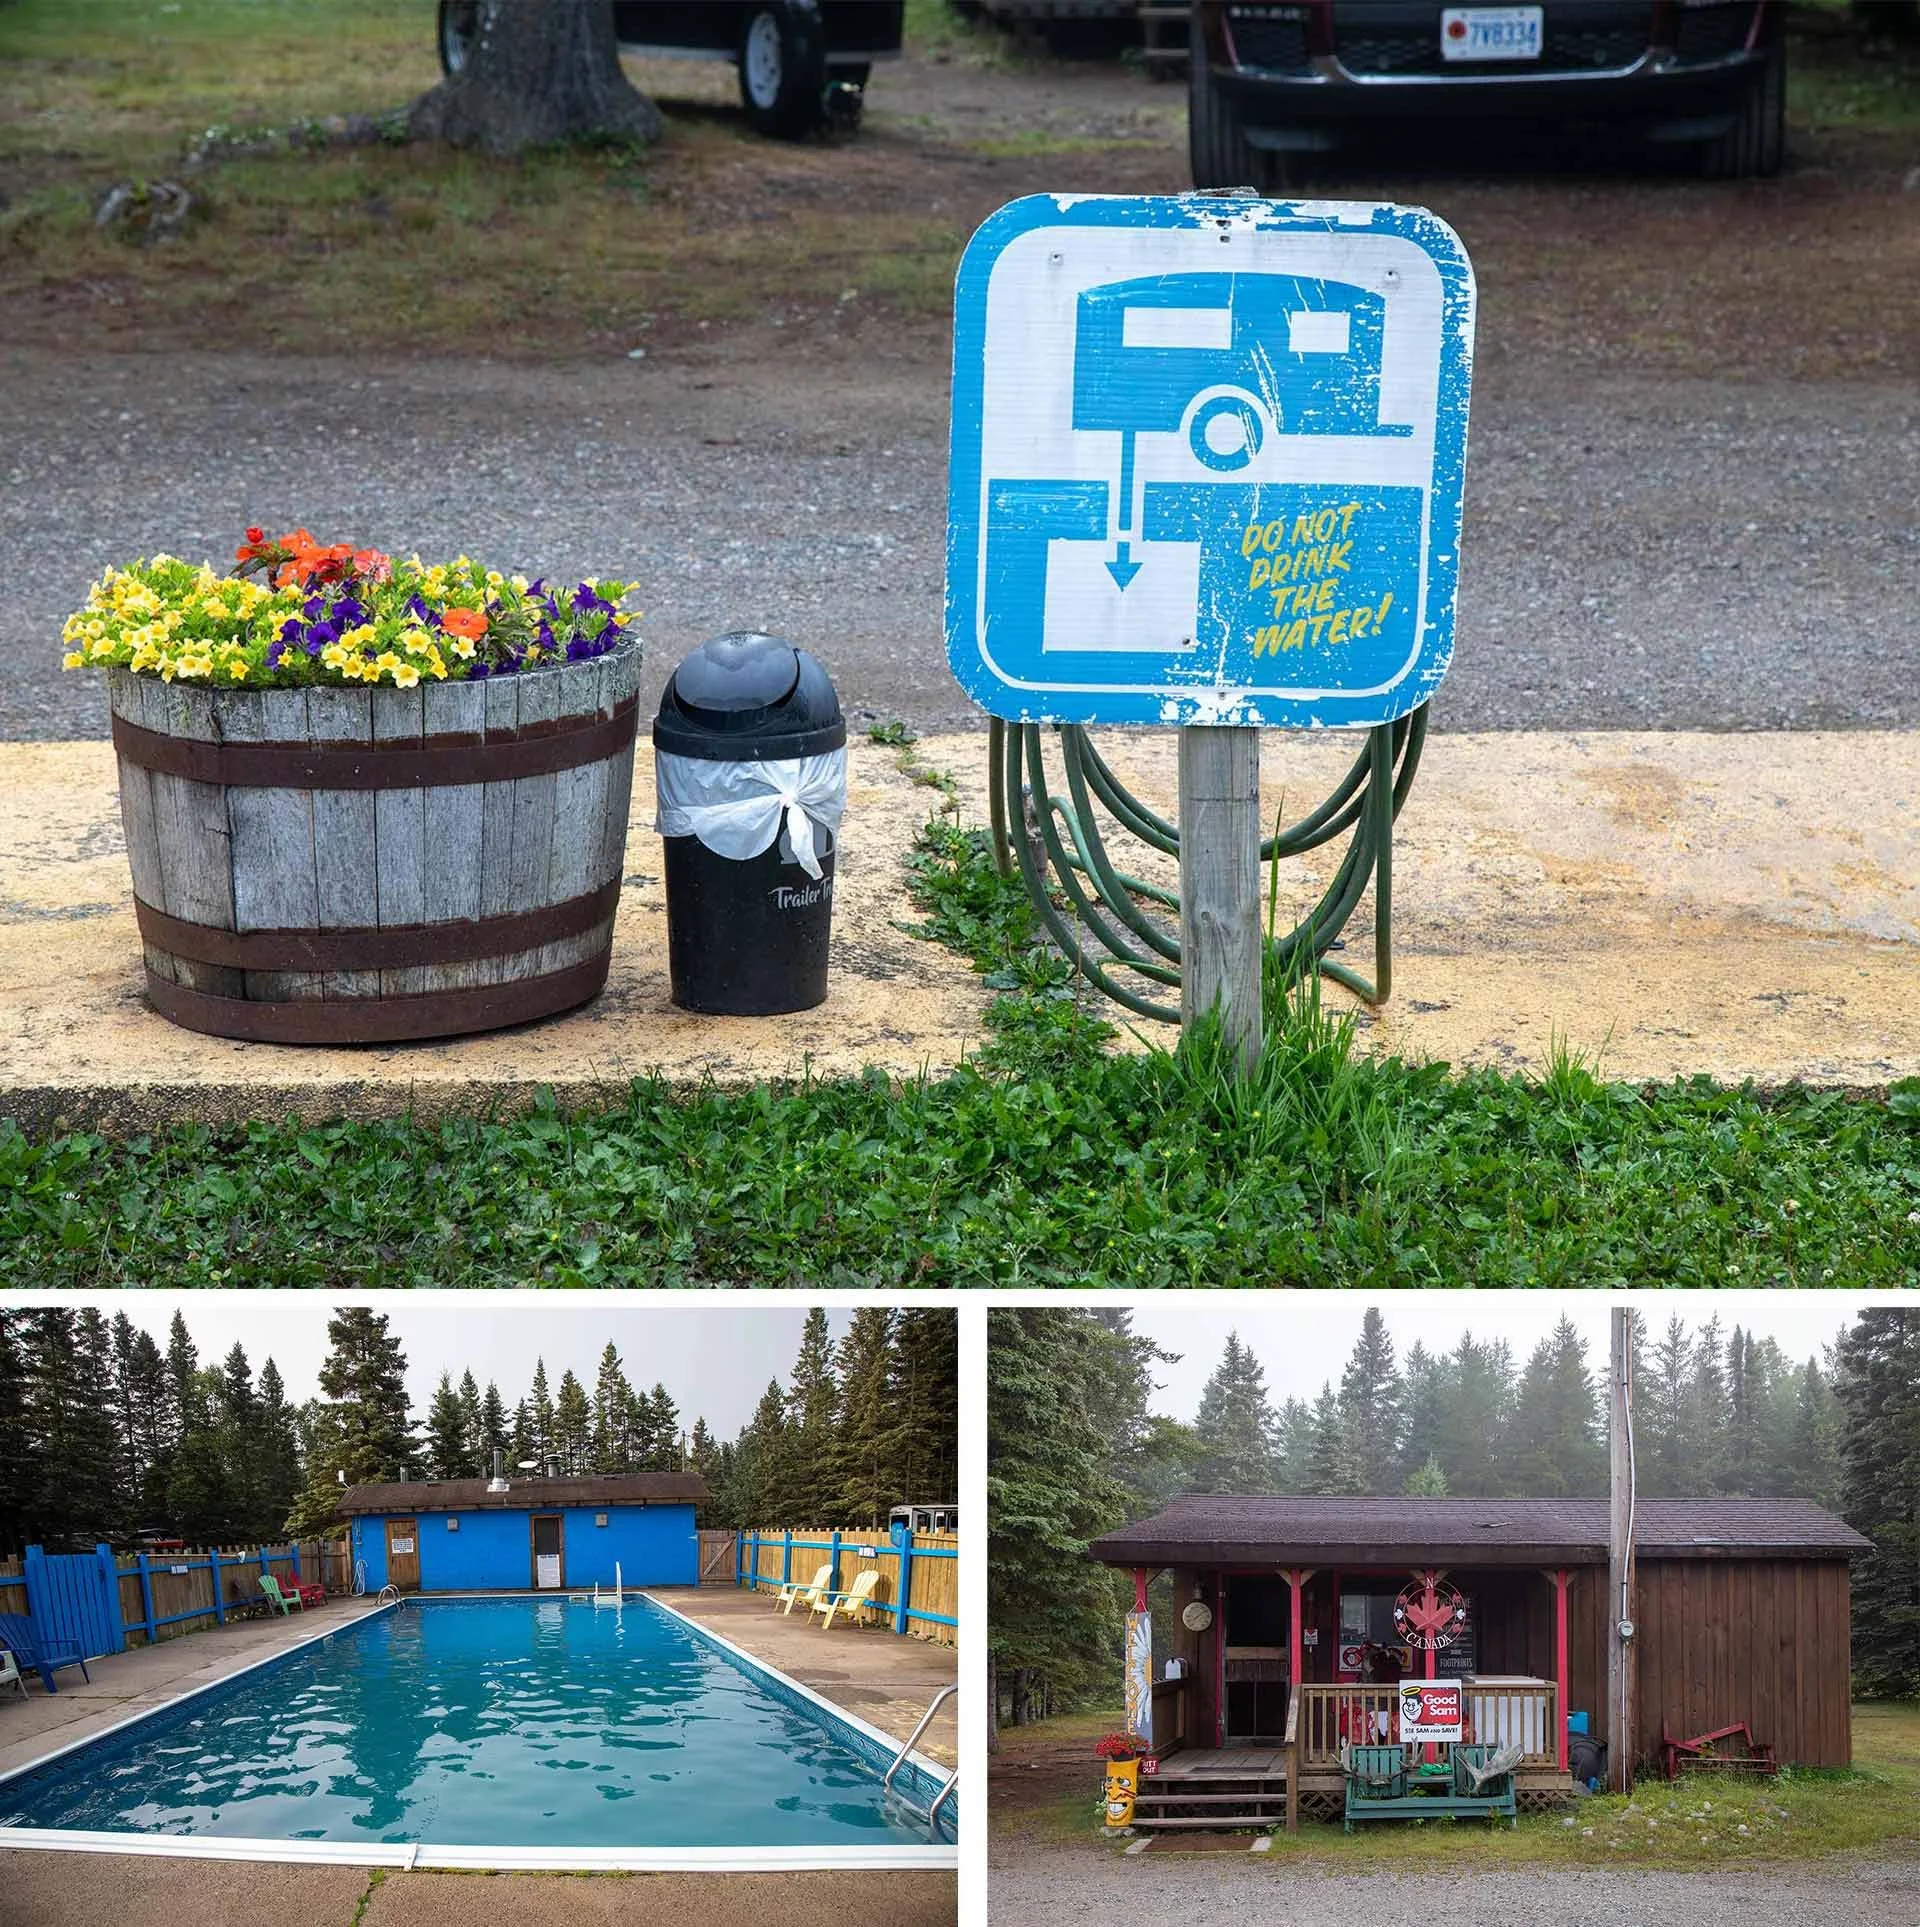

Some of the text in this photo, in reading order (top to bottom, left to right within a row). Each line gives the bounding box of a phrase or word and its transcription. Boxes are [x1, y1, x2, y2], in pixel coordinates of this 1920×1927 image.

[1241, 503, 1362, 557] DO NOT
[1249, 540, 1354, 592] DRINK
[1270, 578, 1339, 619] THE
[1253, 591, 1394, 659] WATER!
[768, 885, 821, 909] Trailer
[1405, 1632, 1453, 1650] CANADA
[1423, 1693, 1457, 1705] Good
[1429, 1704, 1457, 1716] Sam
